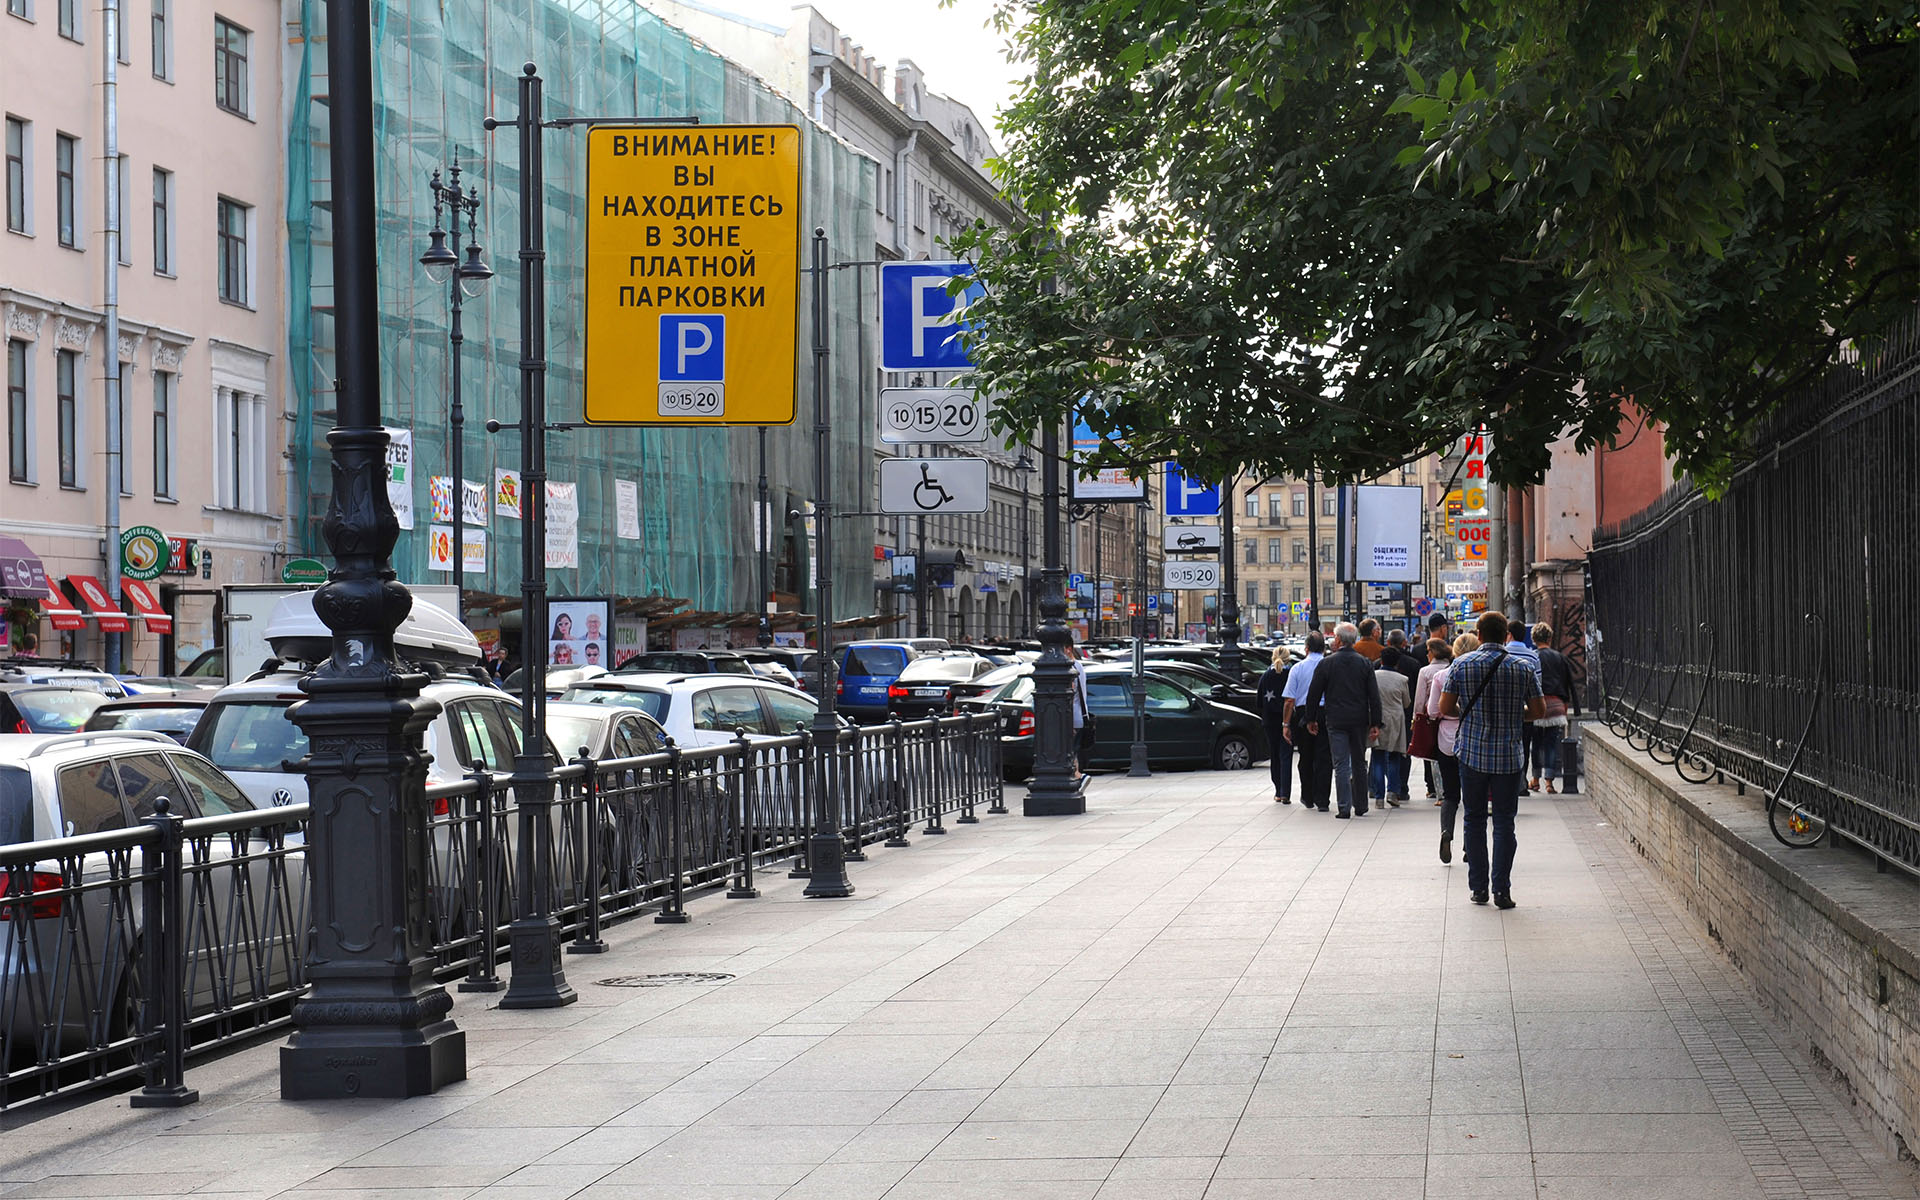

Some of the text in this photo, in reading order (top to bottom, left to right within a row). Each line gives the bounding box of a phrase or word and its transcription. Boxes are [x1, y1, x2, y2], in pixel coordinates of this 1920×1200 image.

[613, 134, 775, 156] ВНИМАНИЕ!
[673, 165, 714, 187] ВЫ
[603, 194, 783, 221] НАХОДИТЕСЬ
[646, 225, 740, 248] В ЗОНЕ
[630, 249, 756, 278] ПЛАТНОЙ
[619, 286, 766, 308] ПАРКОВКИ
[911, 275, 967, 358] P
[677, 322, 713, 374] P
[666, 392, 716, 407] 10 15 20
[894, 404, 974, 427] 10 15 20
[120, 527, 163, 545] COFFEESHOP
[123, 565, 160, 579] COMPANY
[1170, 569, 1213, 582] 10 15 20
